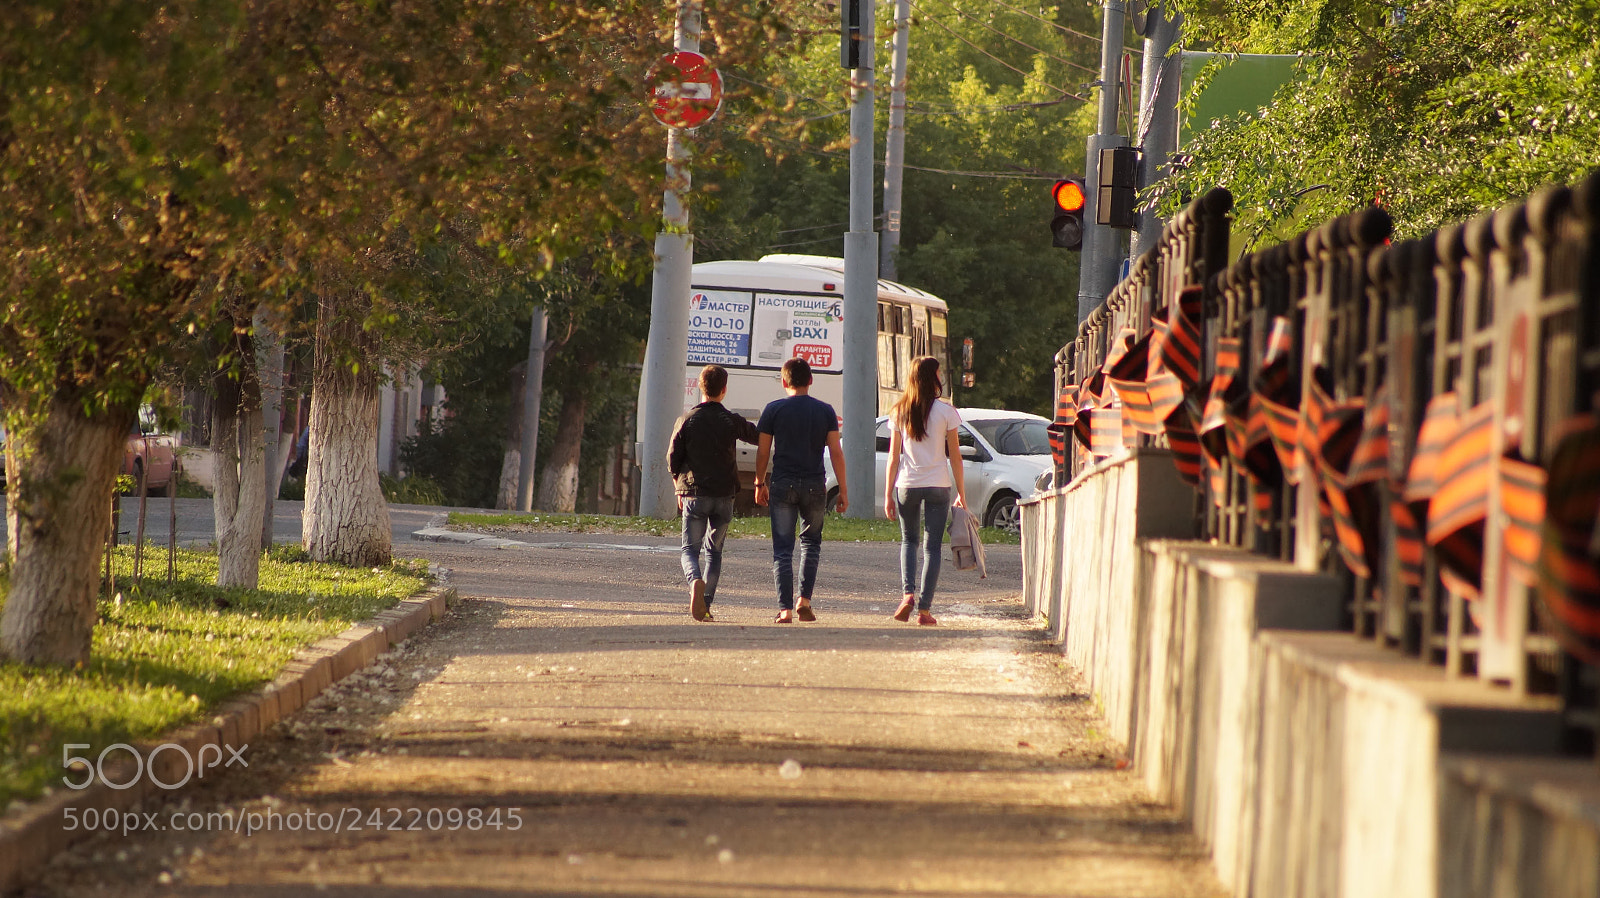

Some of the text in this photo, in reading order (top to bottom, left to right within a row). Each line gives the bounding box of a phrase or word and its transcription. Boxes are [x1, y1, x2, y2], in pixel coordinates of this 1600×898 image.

[708, 302, 749, 313] МАСТЕР
[758, 298, 828, 310] НАСТОЯЩИЕ
[689, 316, 744, 330] 0-10-10
[808, 354, 830, 364] ЛЕТ
